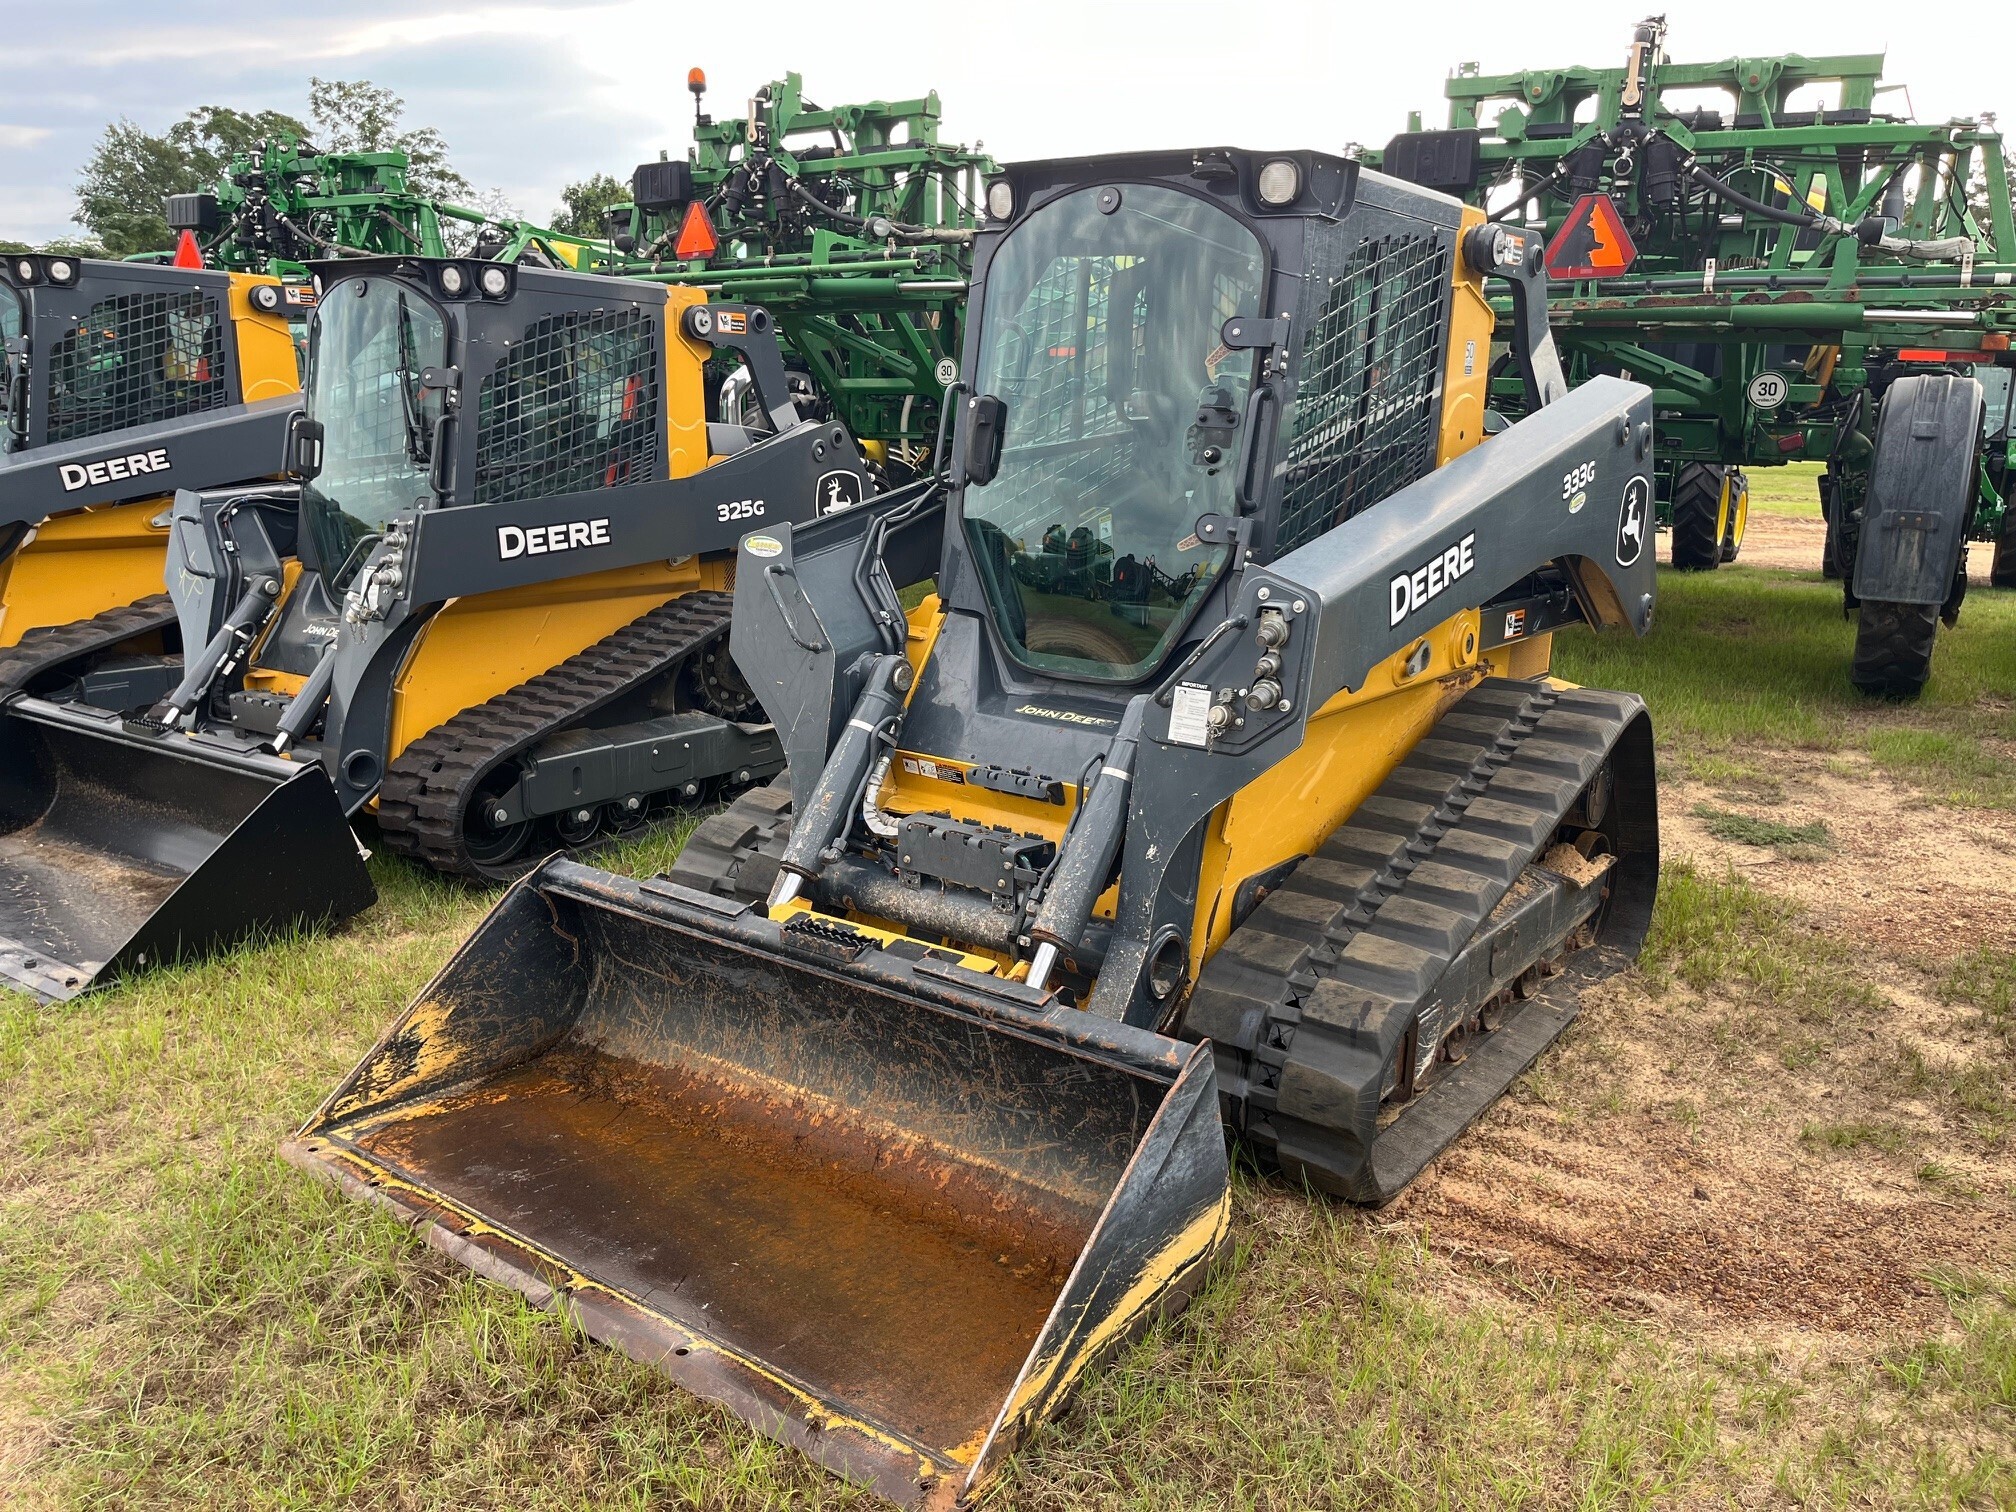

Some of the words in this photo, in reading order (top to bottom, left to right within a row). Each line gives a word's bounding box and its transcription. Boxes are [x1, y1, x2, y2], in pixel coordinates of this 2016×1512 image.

[941, 365, 952, 376] 30
[1757, 382, 1778, 397] 30
[59, 448, 171, 492] DEERE
[1562, 460, 1596, 500] 333G
[717, 499, 765, 522] 325G
[498, 518, 611, 559] DEERE
[1390, 532, 1475, 627] DEERE
[302, 623, 328, 636] JOHN
[1181, 681, 1208, 690] IMPORTANT
[1014, 704, 1061, 719] JOHN
